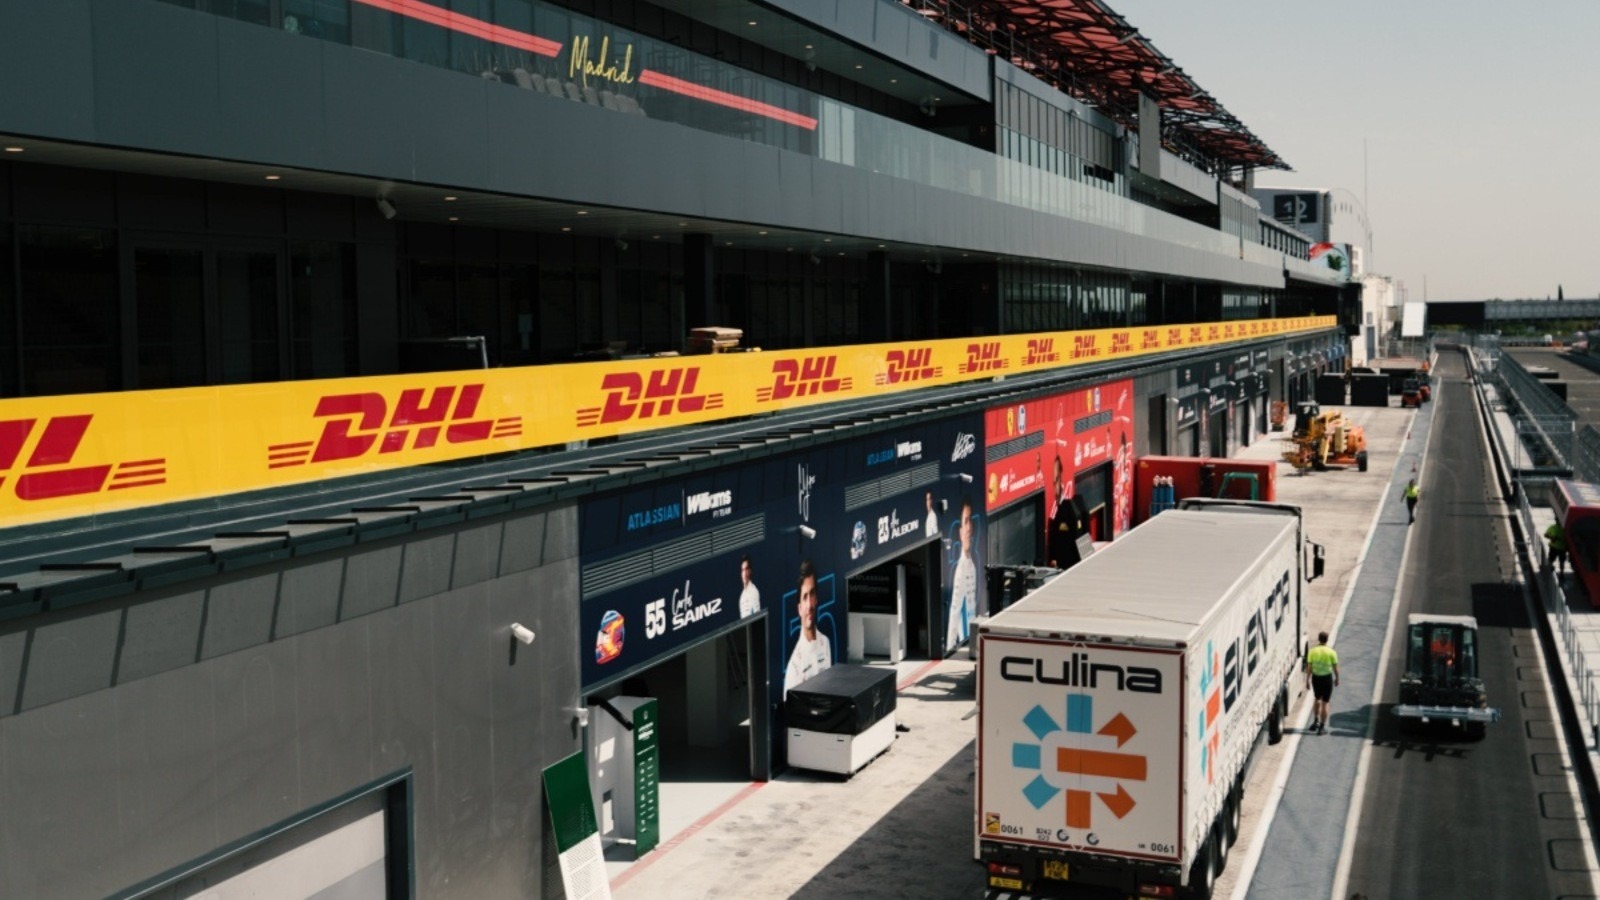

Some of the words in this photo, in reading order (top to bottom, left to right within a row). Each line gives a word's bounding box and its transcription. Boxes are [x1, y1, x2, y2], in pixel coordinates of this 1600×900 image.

[569, 35, 634, 88] Madrid
[1283, 201, 1308, 219] 12
[966, 342, 1003, 373] DHL
[1027, 338, 1055, 365] DHL
[1074, 334, 1096, 358] DHL
[1112, 332, 1130, 353] DHL
[771, 355, 841, 400] DHL
[885, 348, 934, 384] DHL
[600, 367, 707, 424] DHL
[311, 383, 495, 463] DHL
[627, 503, 680, 531] ATLASSIAN
[687, 490, 732, 515] Williams
[891, 519, 919, 540] ALBON
[645, 597, 666, 639] 55
[672, 598, 722, 631] SAINZ
[1000, 652, 1162, 694] culina
[1001, 824, 1024, 835] 0061
[1150, 843, 1175, 854] 0061
